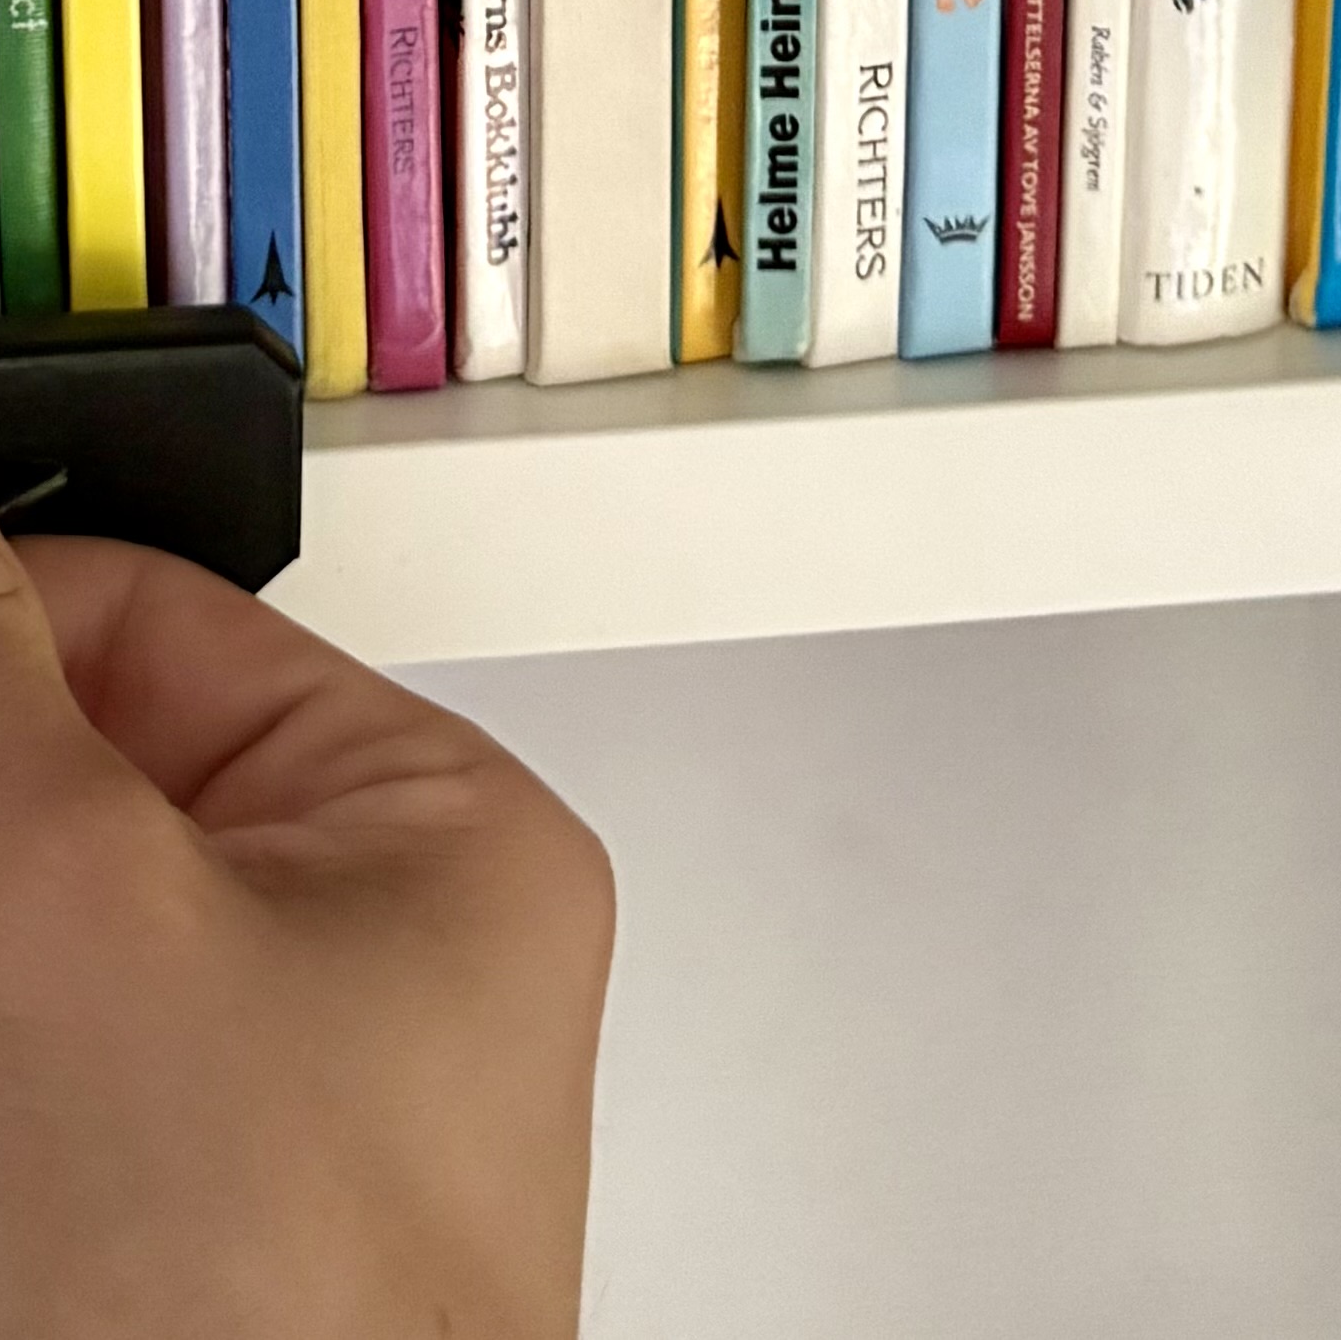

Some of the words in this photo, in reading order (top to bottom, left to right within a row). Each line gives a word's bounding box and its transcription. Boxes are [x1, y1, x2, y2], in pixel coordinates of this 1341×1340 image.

[388, 26, 419, 176] RICHTERS
[1021, 124, 1040, 155] AV
[757, 113, 800, 271] Helme
[855, 60, 894, 281] RICHTERS
[1020, 159, 1039, 215] TOVE
[1146, 258, 1265, 303] TIDEN
